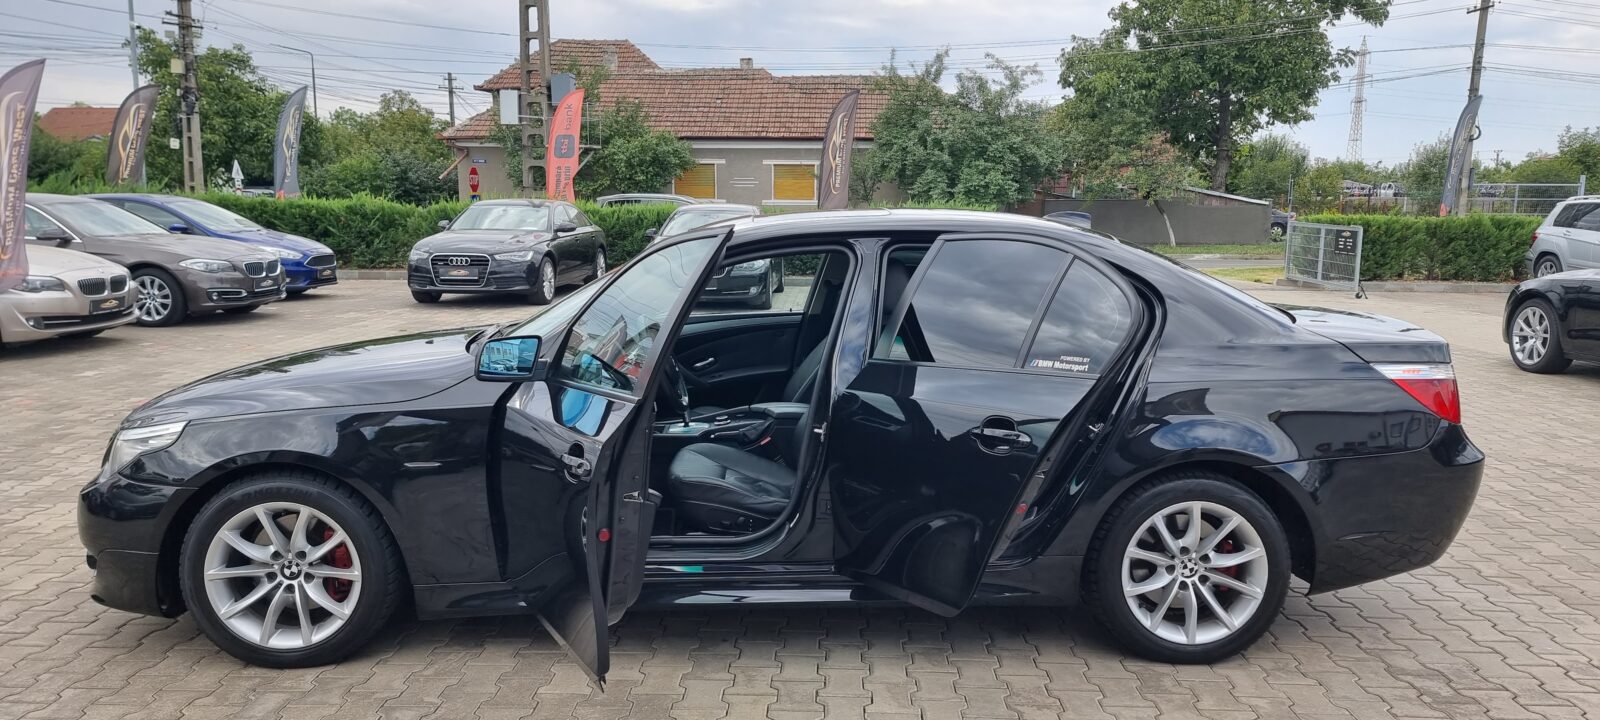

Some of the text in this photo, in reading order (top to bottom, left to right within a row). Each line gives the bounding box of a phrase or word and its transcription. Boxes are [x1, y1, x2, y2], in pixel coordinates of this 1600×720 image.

[564, 103, 573, 130] bank
[560, 138, 569, 154] tbi
[5, 186, 16, 246] PREMIUM
[12, 102, 26, 143] WEST
[1038, 360, 1089, 372] BMW Motorsport
[1060, 355, 1083, 363] POWERED
